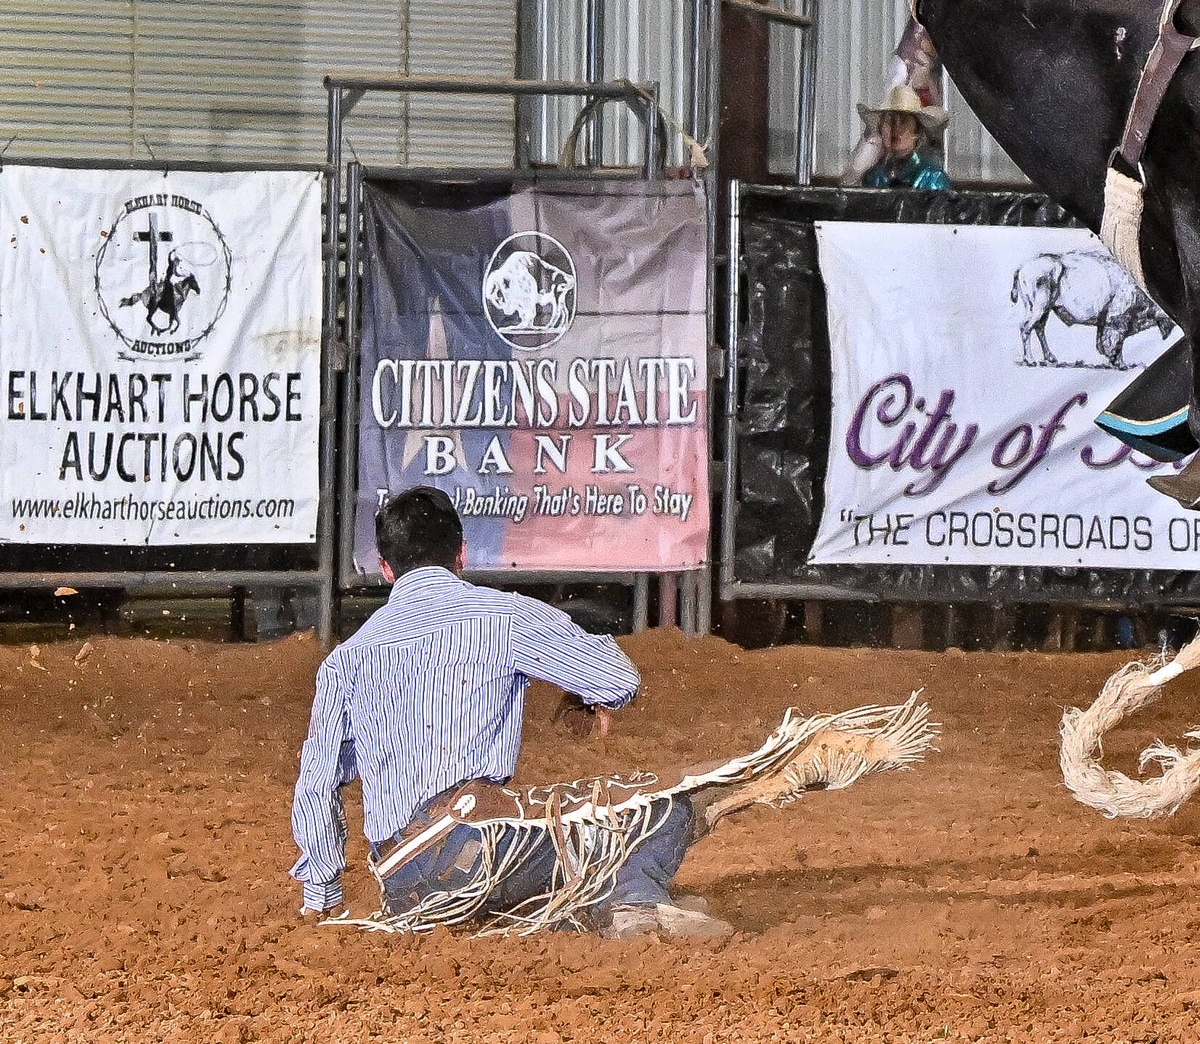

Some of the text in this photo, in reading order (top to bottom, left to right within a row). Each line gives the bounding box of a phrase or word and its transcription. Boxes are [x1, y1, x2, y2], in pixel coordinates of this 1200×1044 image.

[131, 339, 192, 355] AUCTIONS
[7, 370, 302, 423] ELKHART HORSE
[372, 357, 698, 428] CITIZENS STATE
[424, 434, 635, 475] BANK
[845, 372, 1088, 496] City of
[59, 431, 245, 483] AUCTIONS
[12, 493, 294, 521] www.elkharthorseauctions.com
[463, 486, 527, 521] Banking
[533, 486, 580, 515] That's
[585, 488, 622, 514] Here
[628, 485, 645, 514] To
[653, 484, 692, 521] Stay
[925, 511, 1152, 551] CROSSROADS
